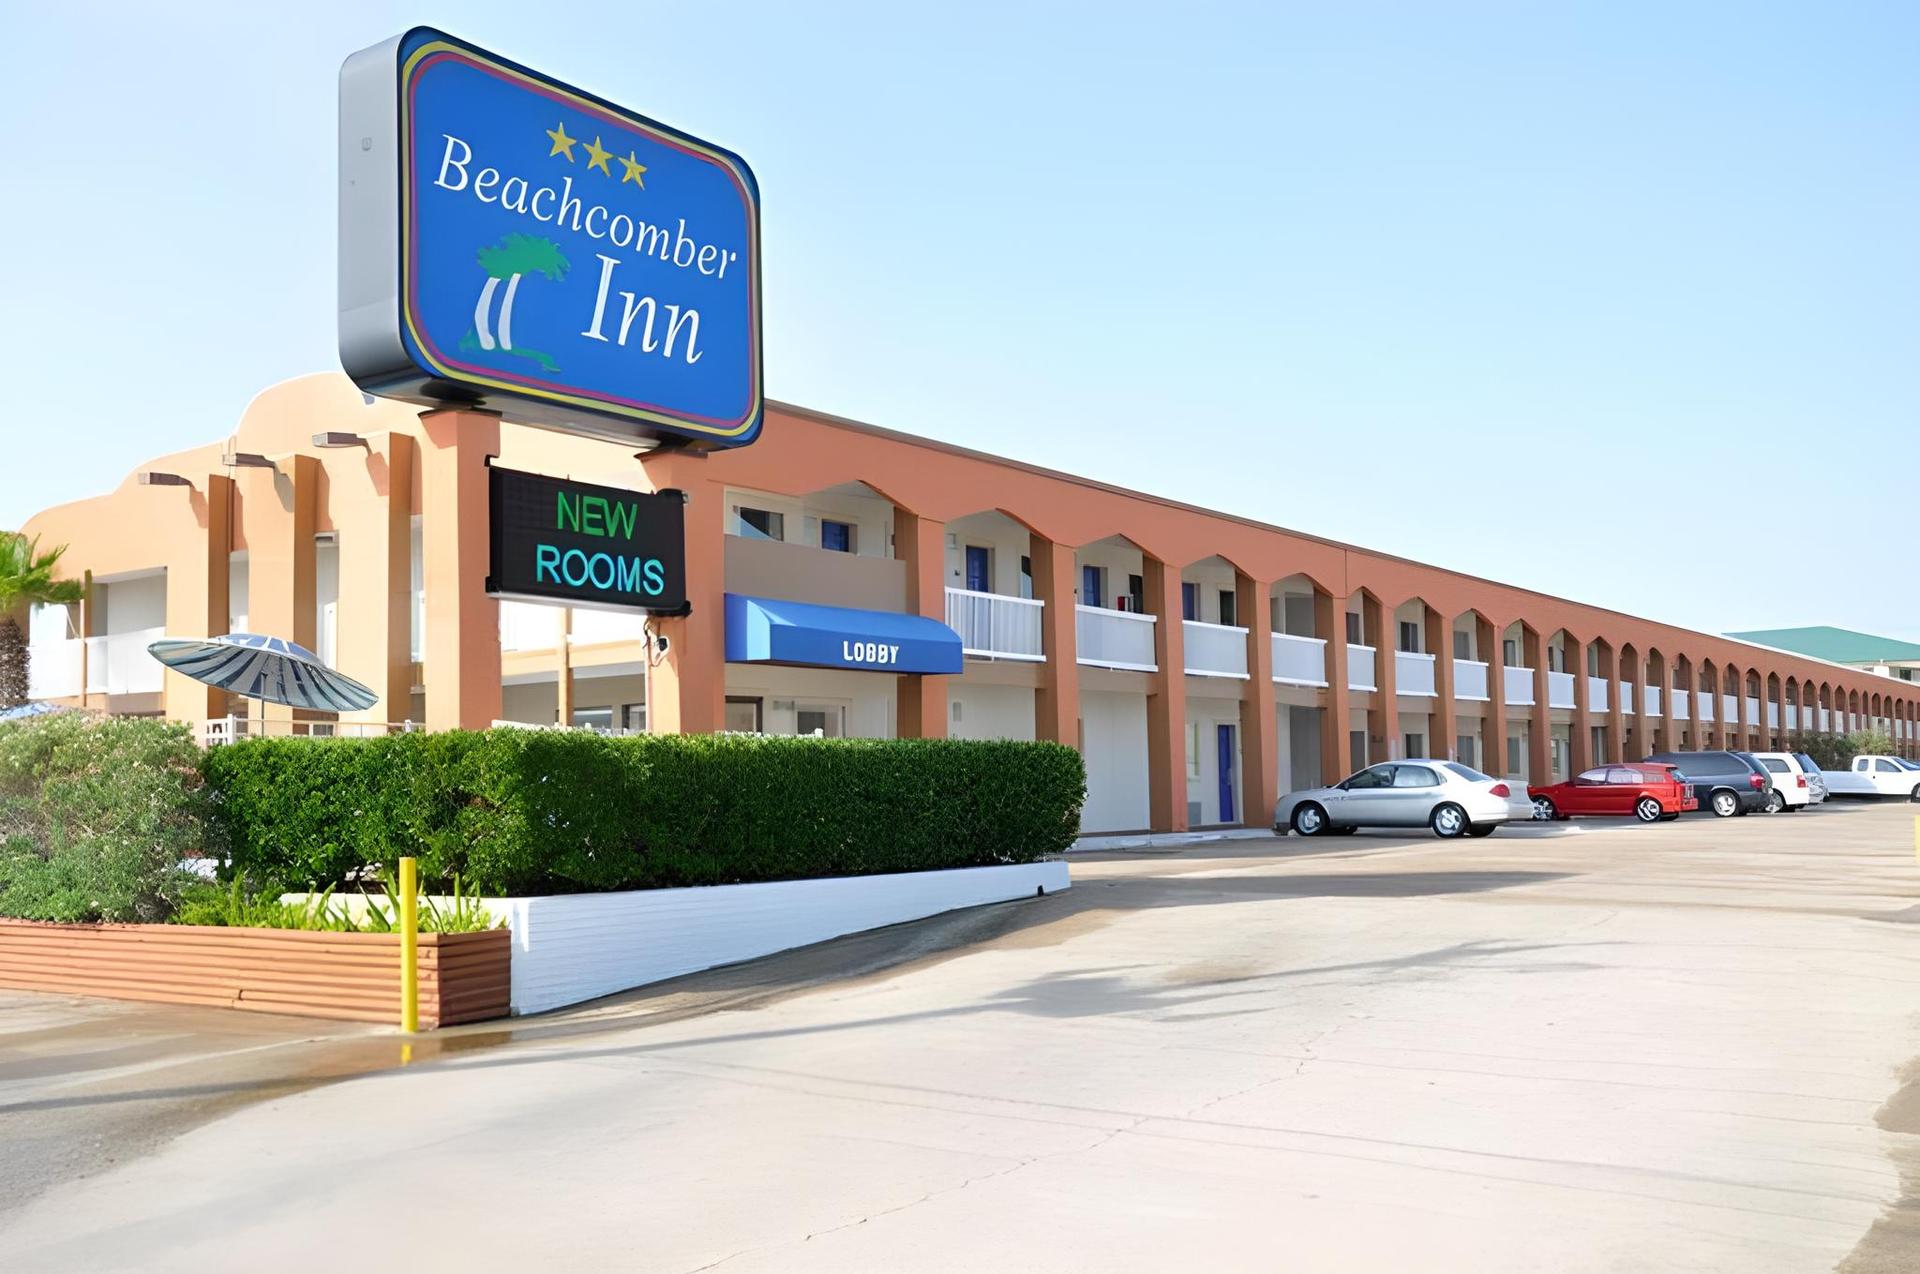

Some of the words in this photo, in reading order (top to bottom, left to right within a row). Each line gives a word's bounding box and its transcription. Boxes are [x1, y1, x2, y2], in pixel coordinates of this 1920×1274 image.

[433, 133, 737, 279] Beachcomber
[580, 253, 703, 365] Inn
[556, 491, 638, 540] NEW
[536, 543, 665, 596] ROOMS
[843, 640, 899, 664] LOBBY
